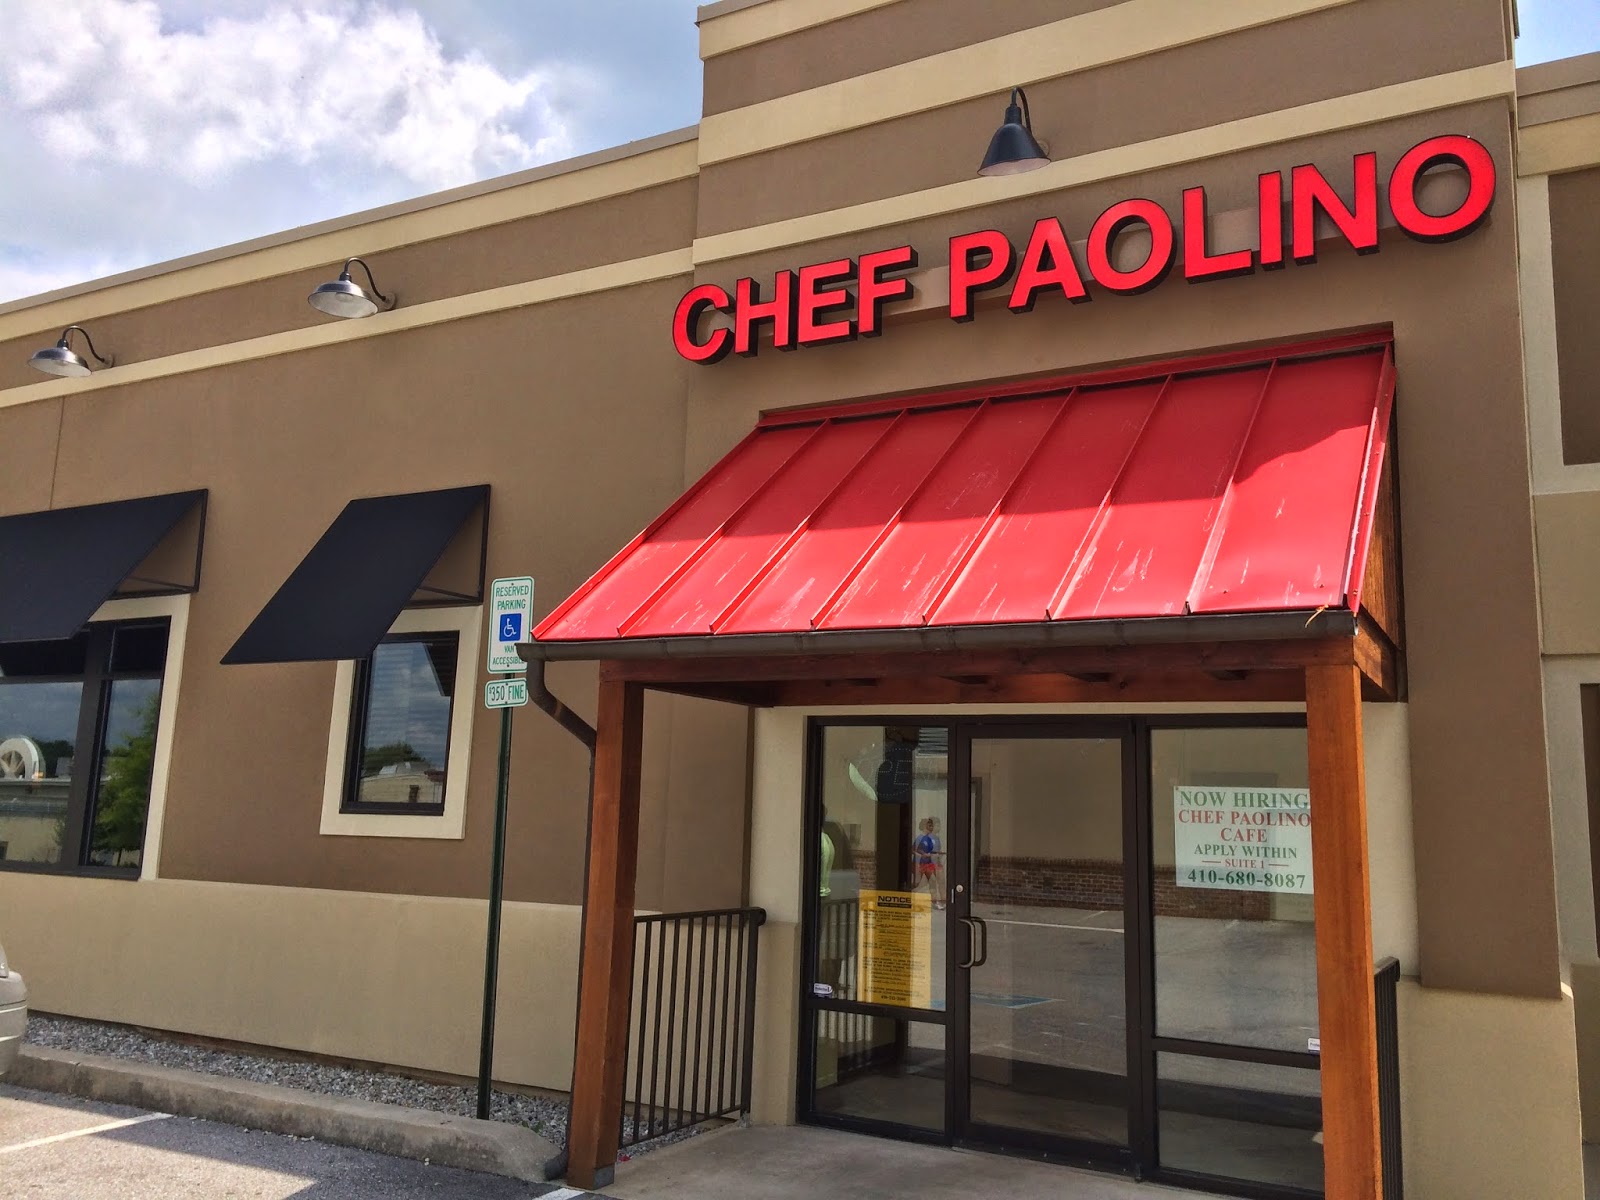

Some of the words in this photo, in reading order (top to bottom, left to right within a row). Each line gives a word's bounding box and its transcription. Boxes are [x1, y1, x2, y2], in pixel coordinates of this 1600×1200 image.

[672, 245, 919, 365] CHEF
[949, 134, 1496, 323] PAOLINO
[495, 585, 529, 597] RESERVED
[497, 599, 526, 611] PARKING
[504, 645, 515, 653] VAN
[492, 656, 525, 665] ACCESSIBL
[489, 685, 505, 701] $350
[508, 684, 525, 700] FINE
[1180, 791, 1226, 807] NOW
[1233, 792, 1309, 809] HIRING
[1178, 809, 1225, 824] CHEF
[1231, 811, 1311, 827] PAOLINO
[1220, 828, 1268, 843] CAFE
[1194, 844, 1237, 857] APPLY
[1242, 845, 1297, 859] WITHIN
[1225, 858, 1257, 869] SUITE
[1260, 860, 1265, 869] 1
[1187, 868, 1306, 889] 410-680-8087
[877, 895, 912, 904] NOTICE
